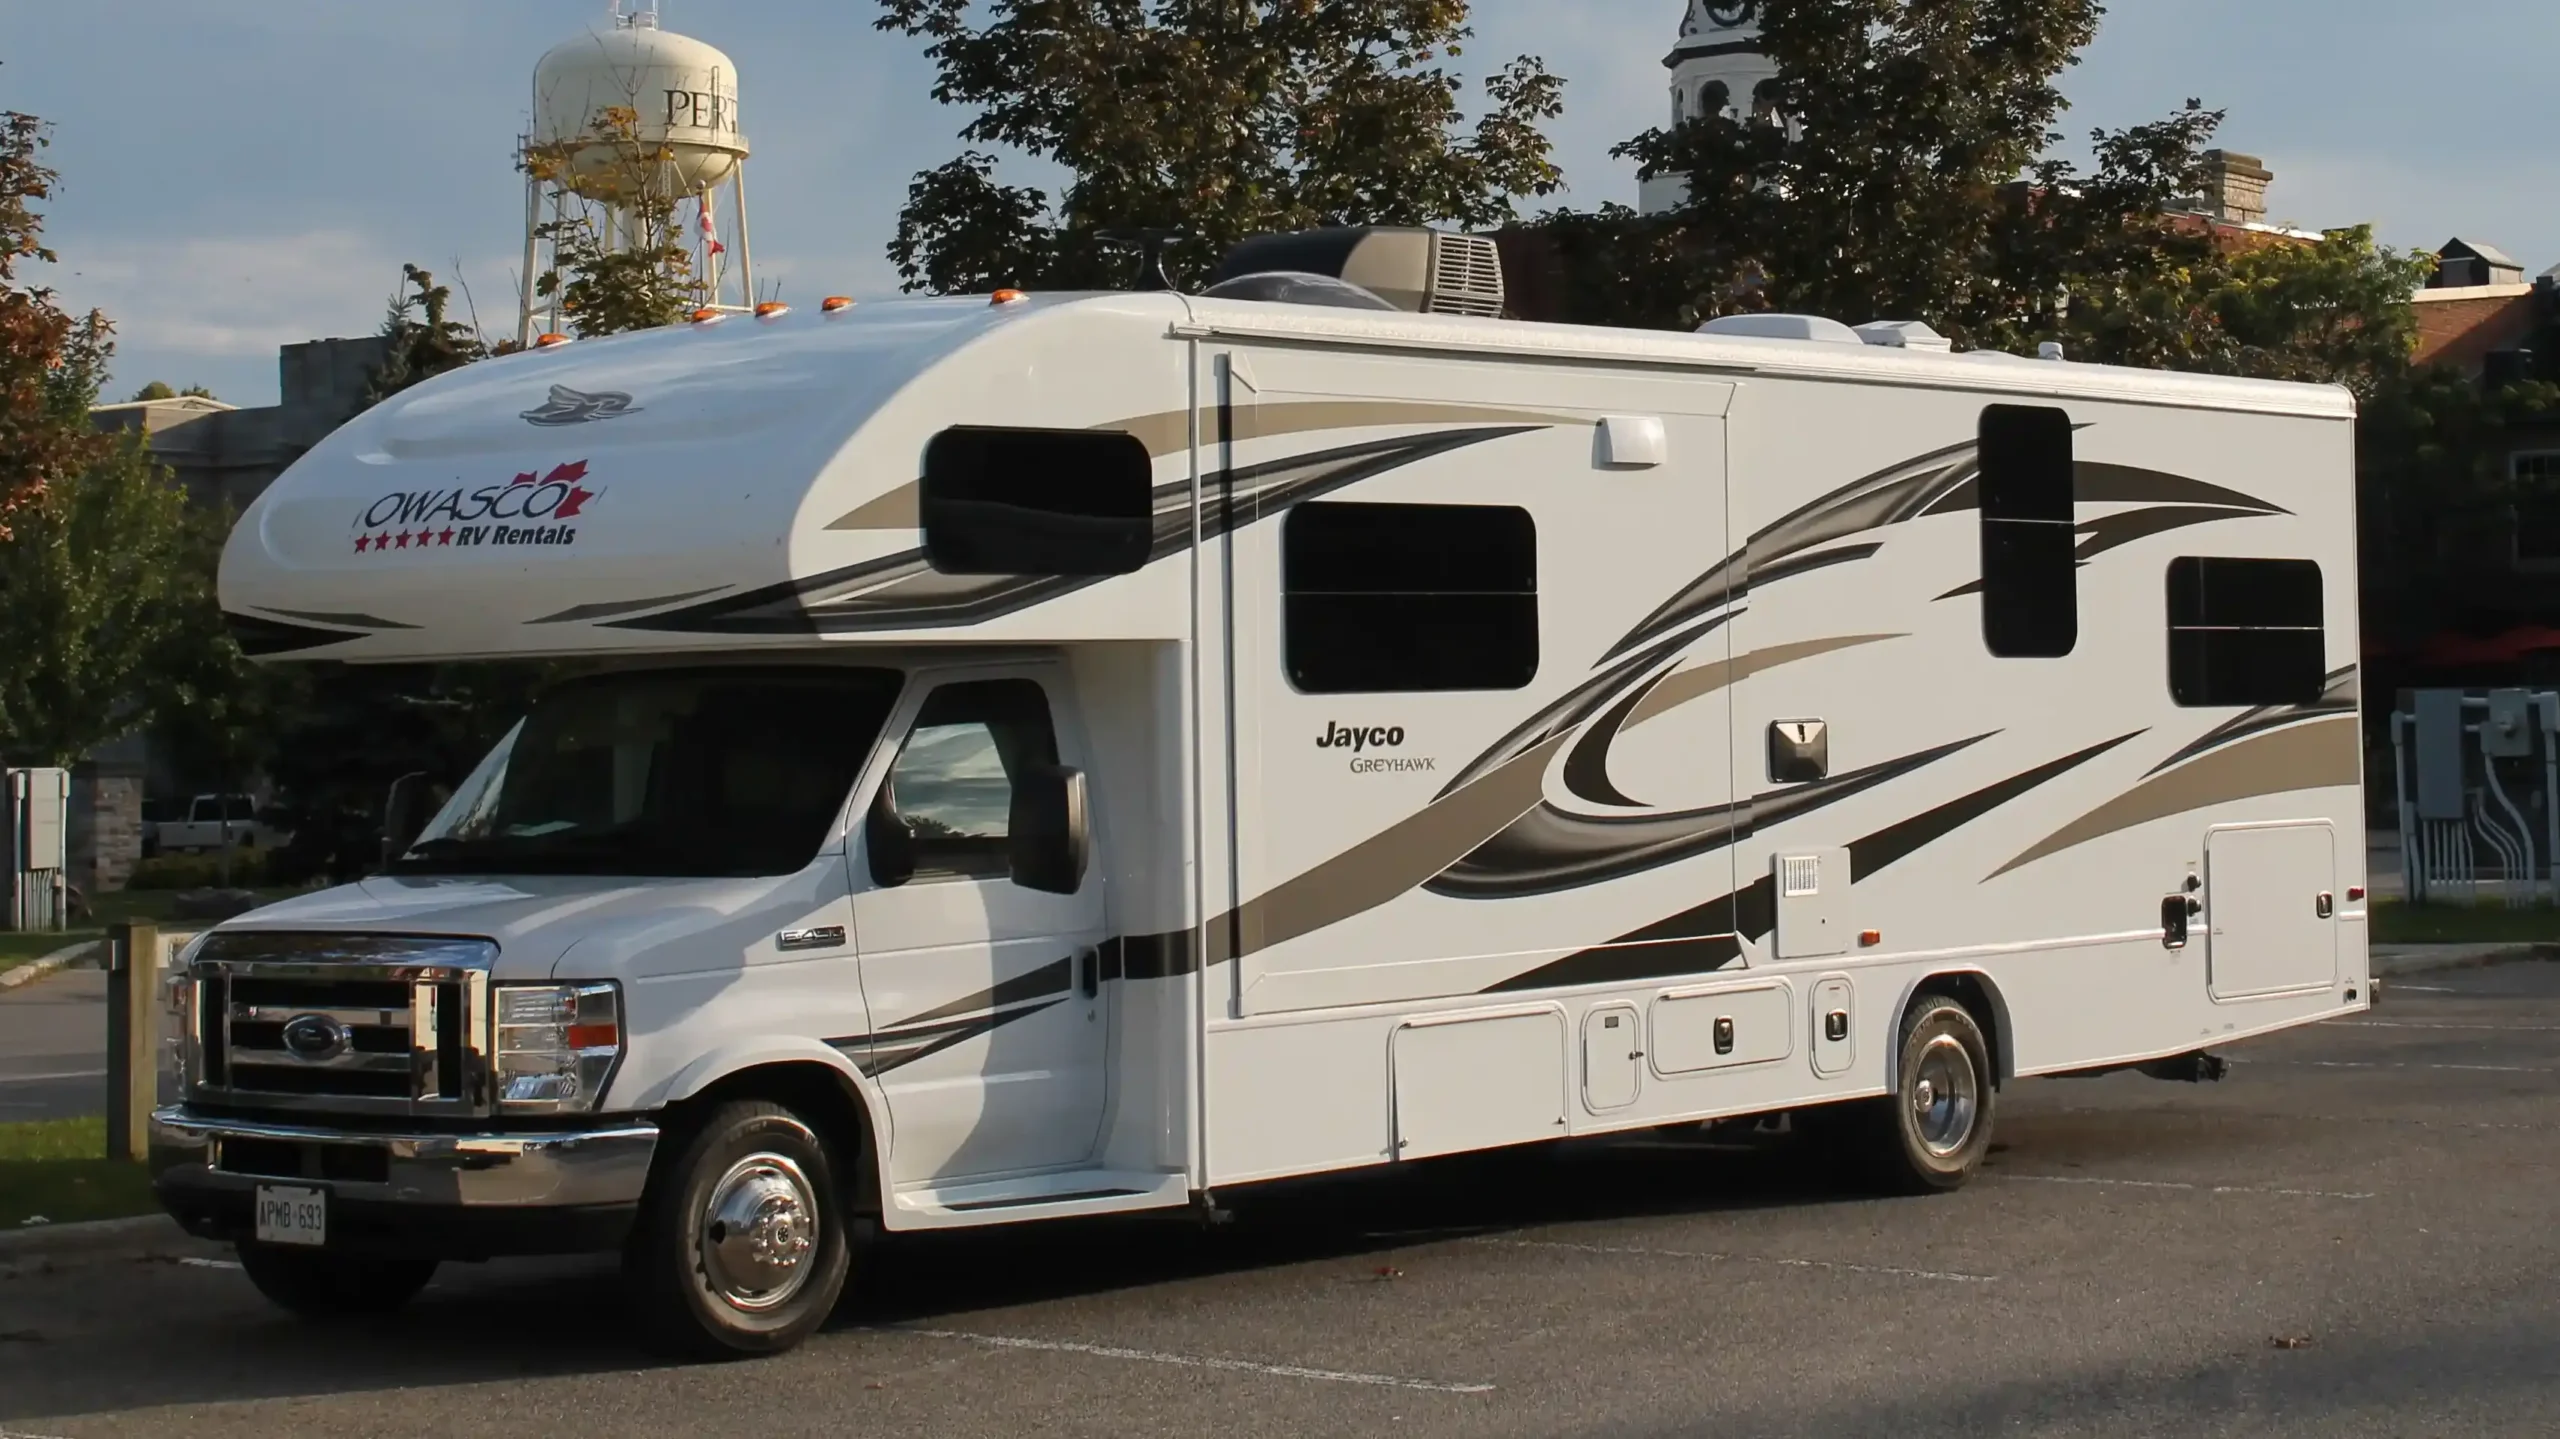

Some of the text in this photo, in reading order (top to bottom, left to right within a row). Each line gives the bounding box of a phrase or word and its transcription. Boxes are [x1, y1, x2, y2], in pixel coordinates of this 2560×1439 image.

[365, 482, 568, 528] OWASCO
[456, 524, 576, 546] RV Rentals
[1316, 720, 1405, 753] Jayco
[260, 1200, 322, 1230] APMB 693
